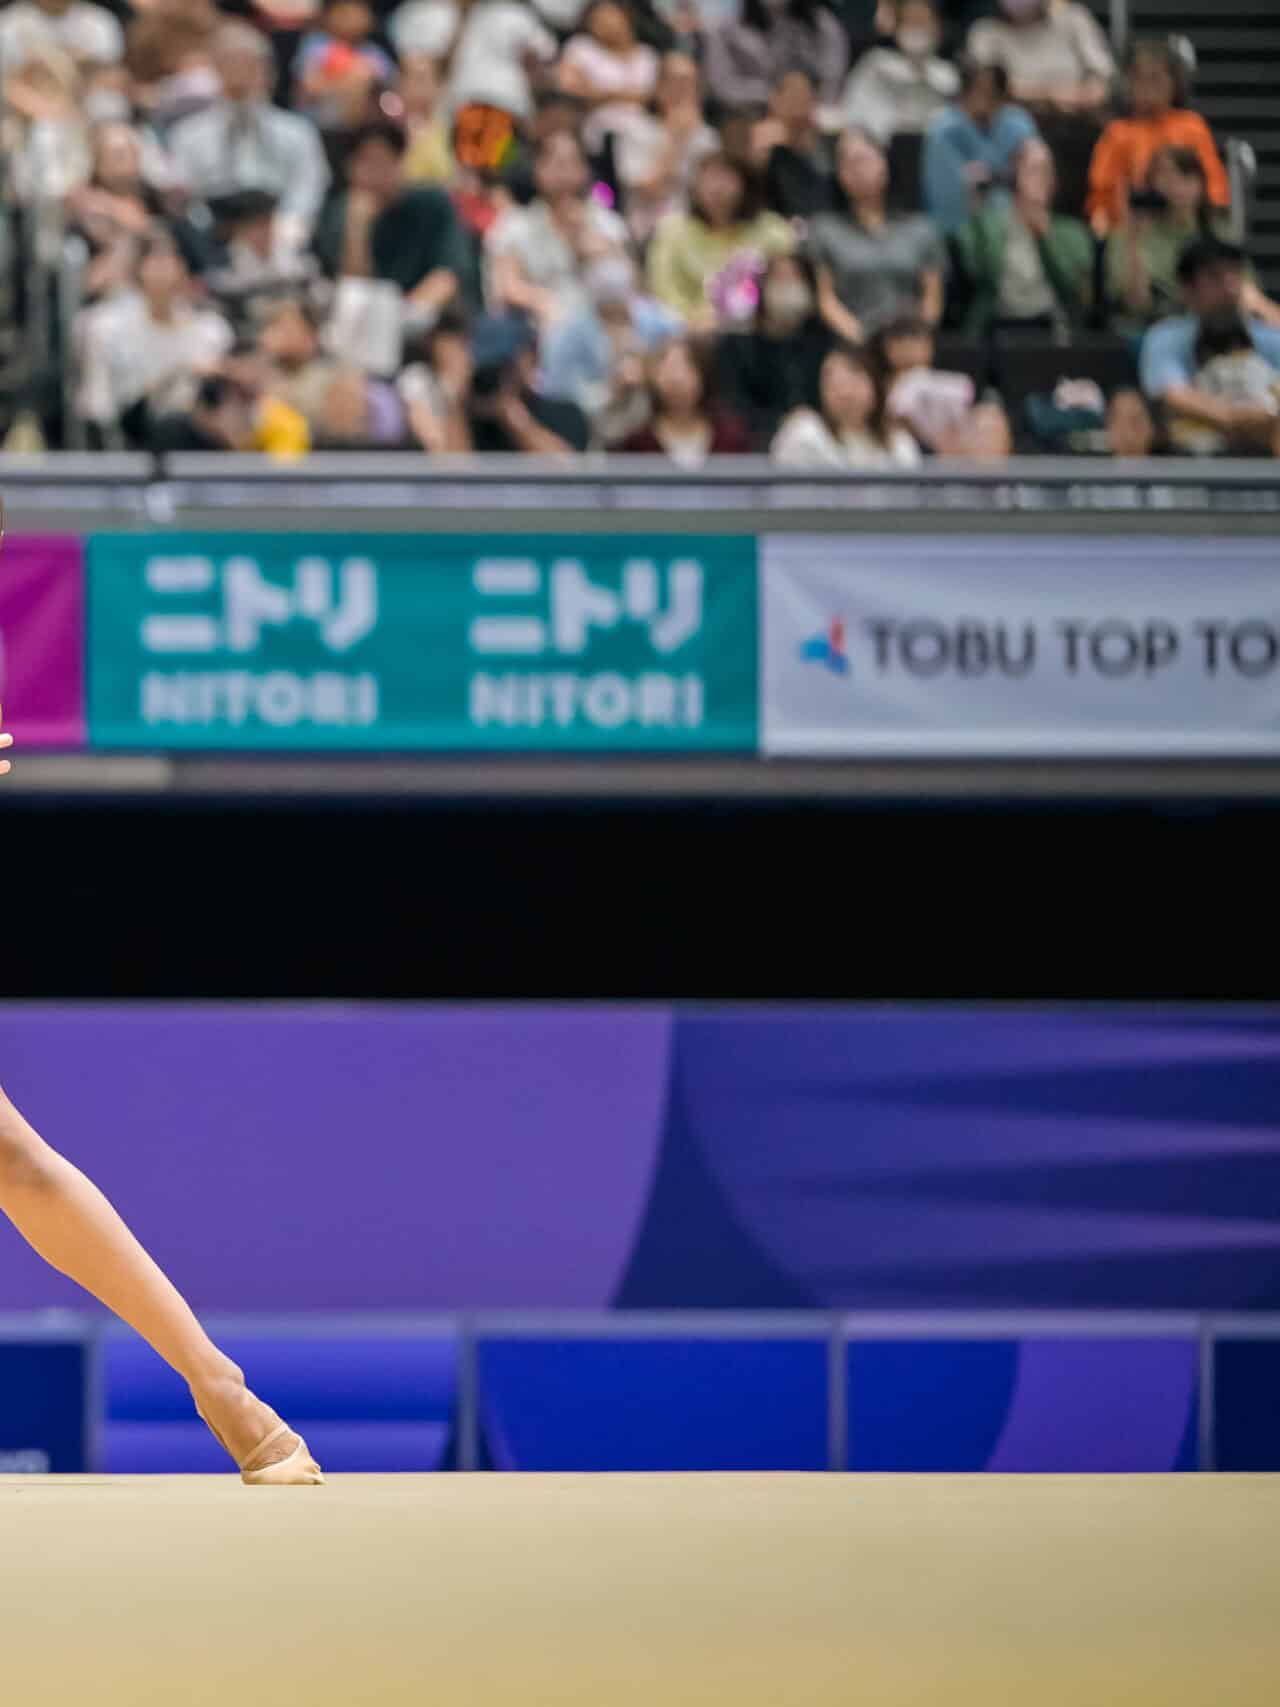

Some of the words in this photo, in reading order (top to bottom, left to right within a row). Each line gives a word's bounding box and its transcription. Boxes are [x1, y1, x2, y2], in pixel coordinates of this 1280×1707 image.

[142, 557, 376, 652] ニトリ
[470, 558, 703, 653] ニトリ
[867, 618, 1035, 678] TOBU
[1057, 618, 1178, 678] TOP
[142, 672, 377, 726] NITORI
[470, 673, 703, 727] NITORI
